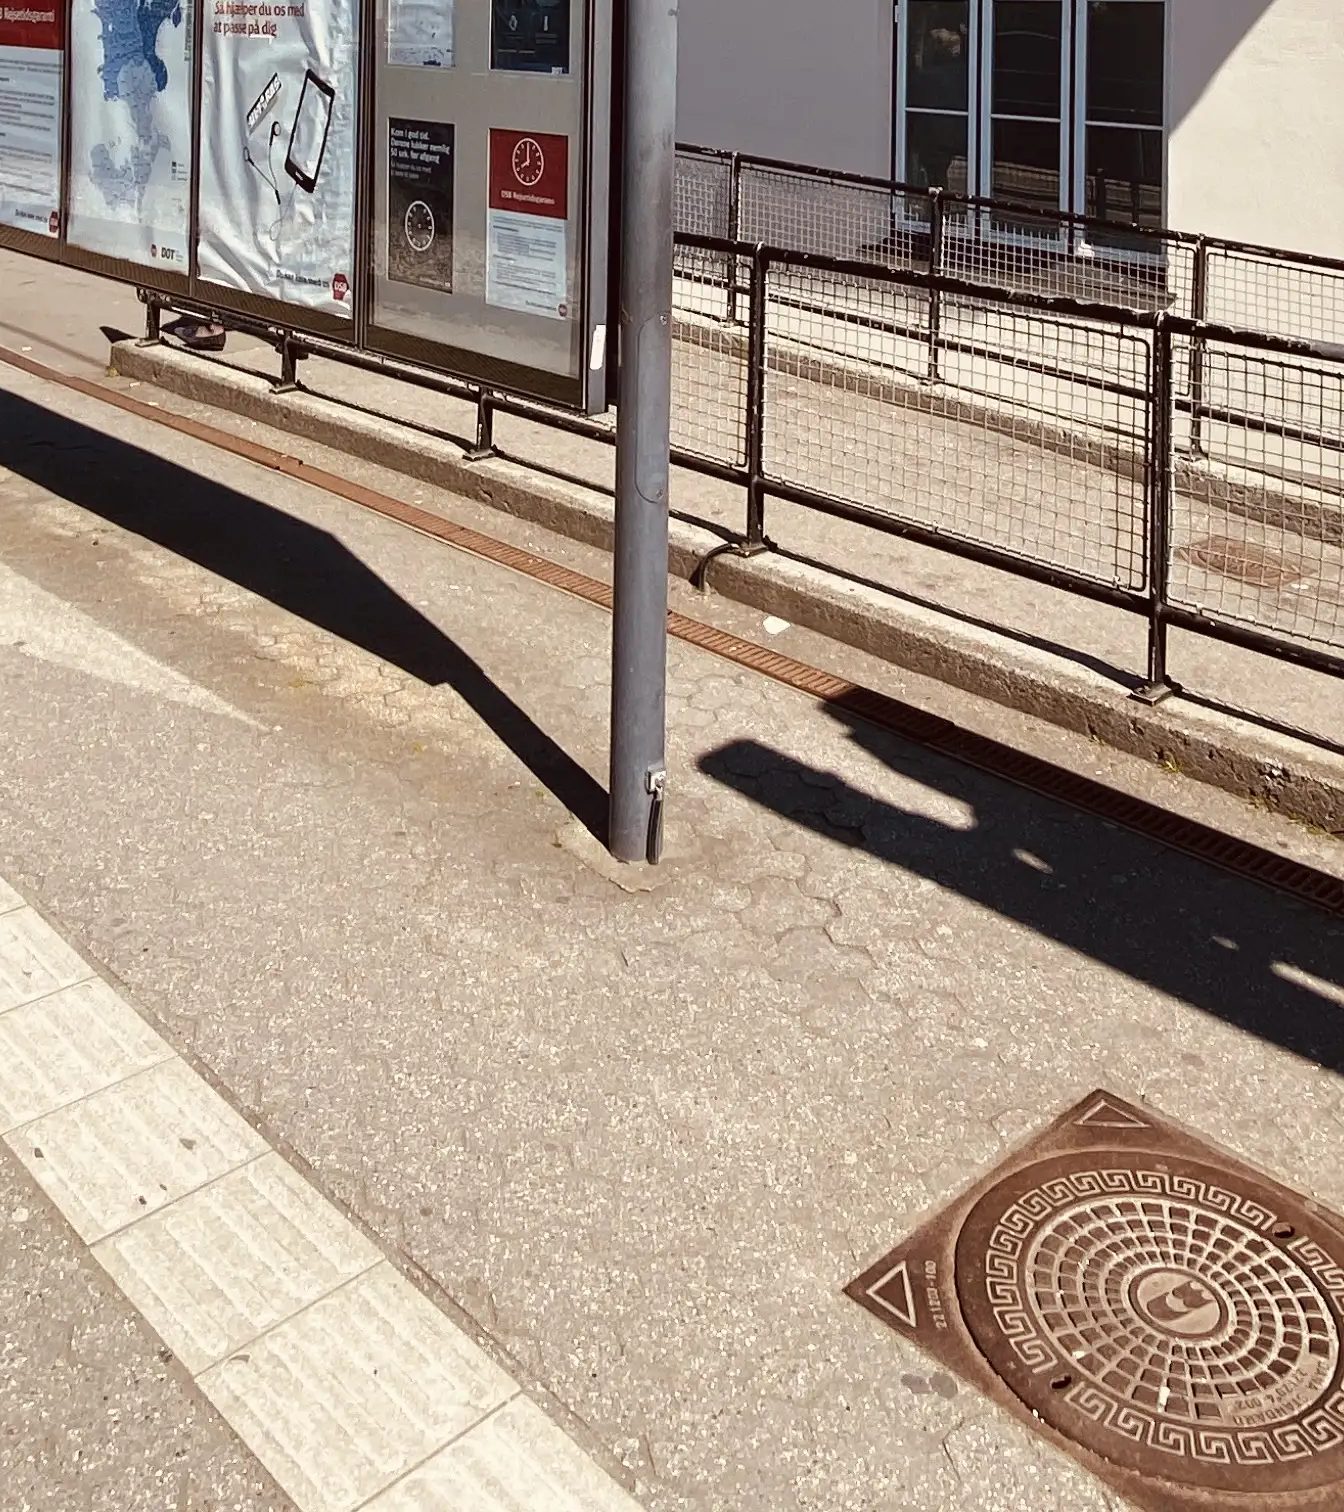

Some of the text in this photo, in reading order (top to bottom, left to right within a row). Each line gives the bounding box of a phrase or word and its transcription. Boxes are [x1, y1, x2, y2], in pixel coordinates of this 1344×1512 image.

[215, 1, 305, 18] Så hjælper du os med
[213, 20, 277, 37] at passe på dig
[161, 246, 175, 260] DOT
[334, 281, 348, 293] DSB
